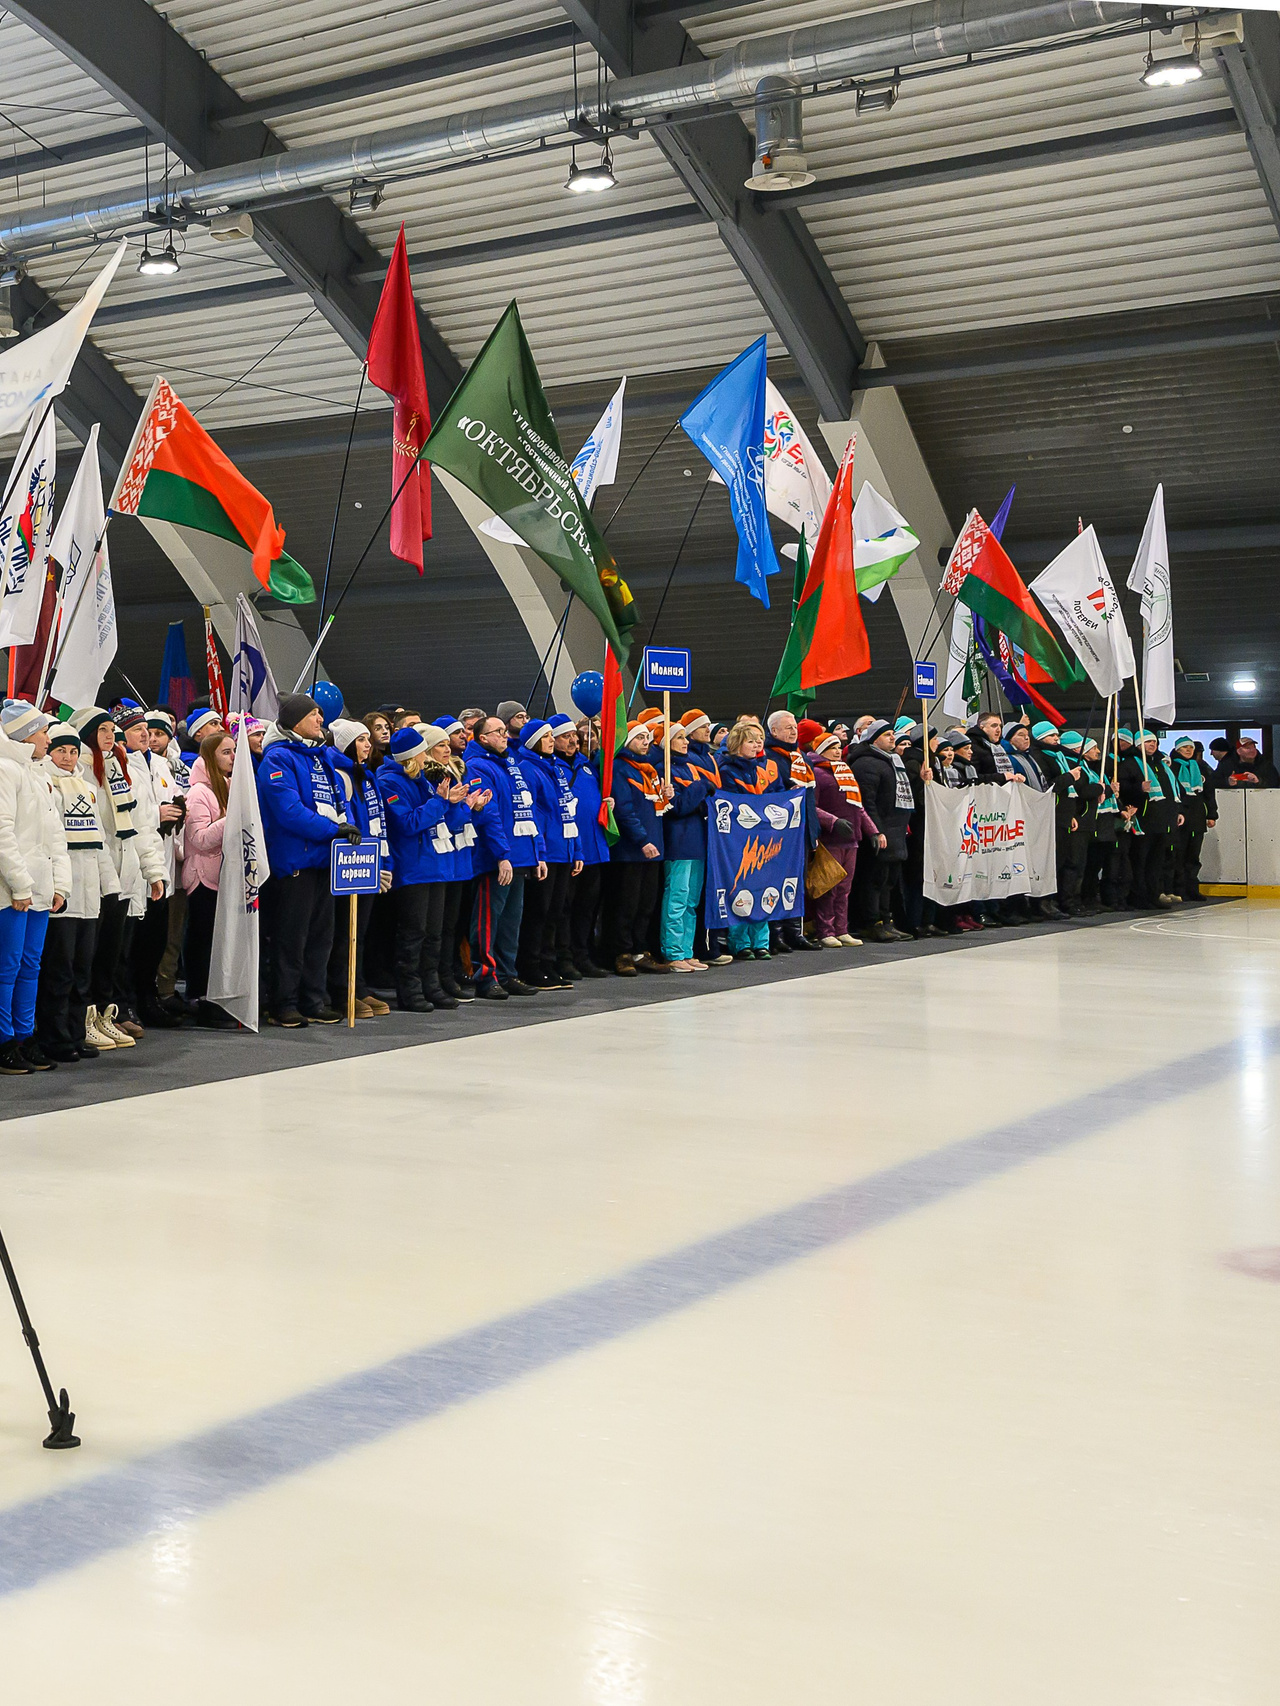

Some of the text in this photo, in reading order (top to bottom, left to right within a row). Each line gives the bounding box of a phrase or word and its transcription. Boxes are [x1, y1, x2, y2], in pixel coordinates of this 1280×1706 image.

[650, 661, 684, 677] Молния
[337, 850, 375, 866] Академия
[341, 867, 371, 882] сервиса
